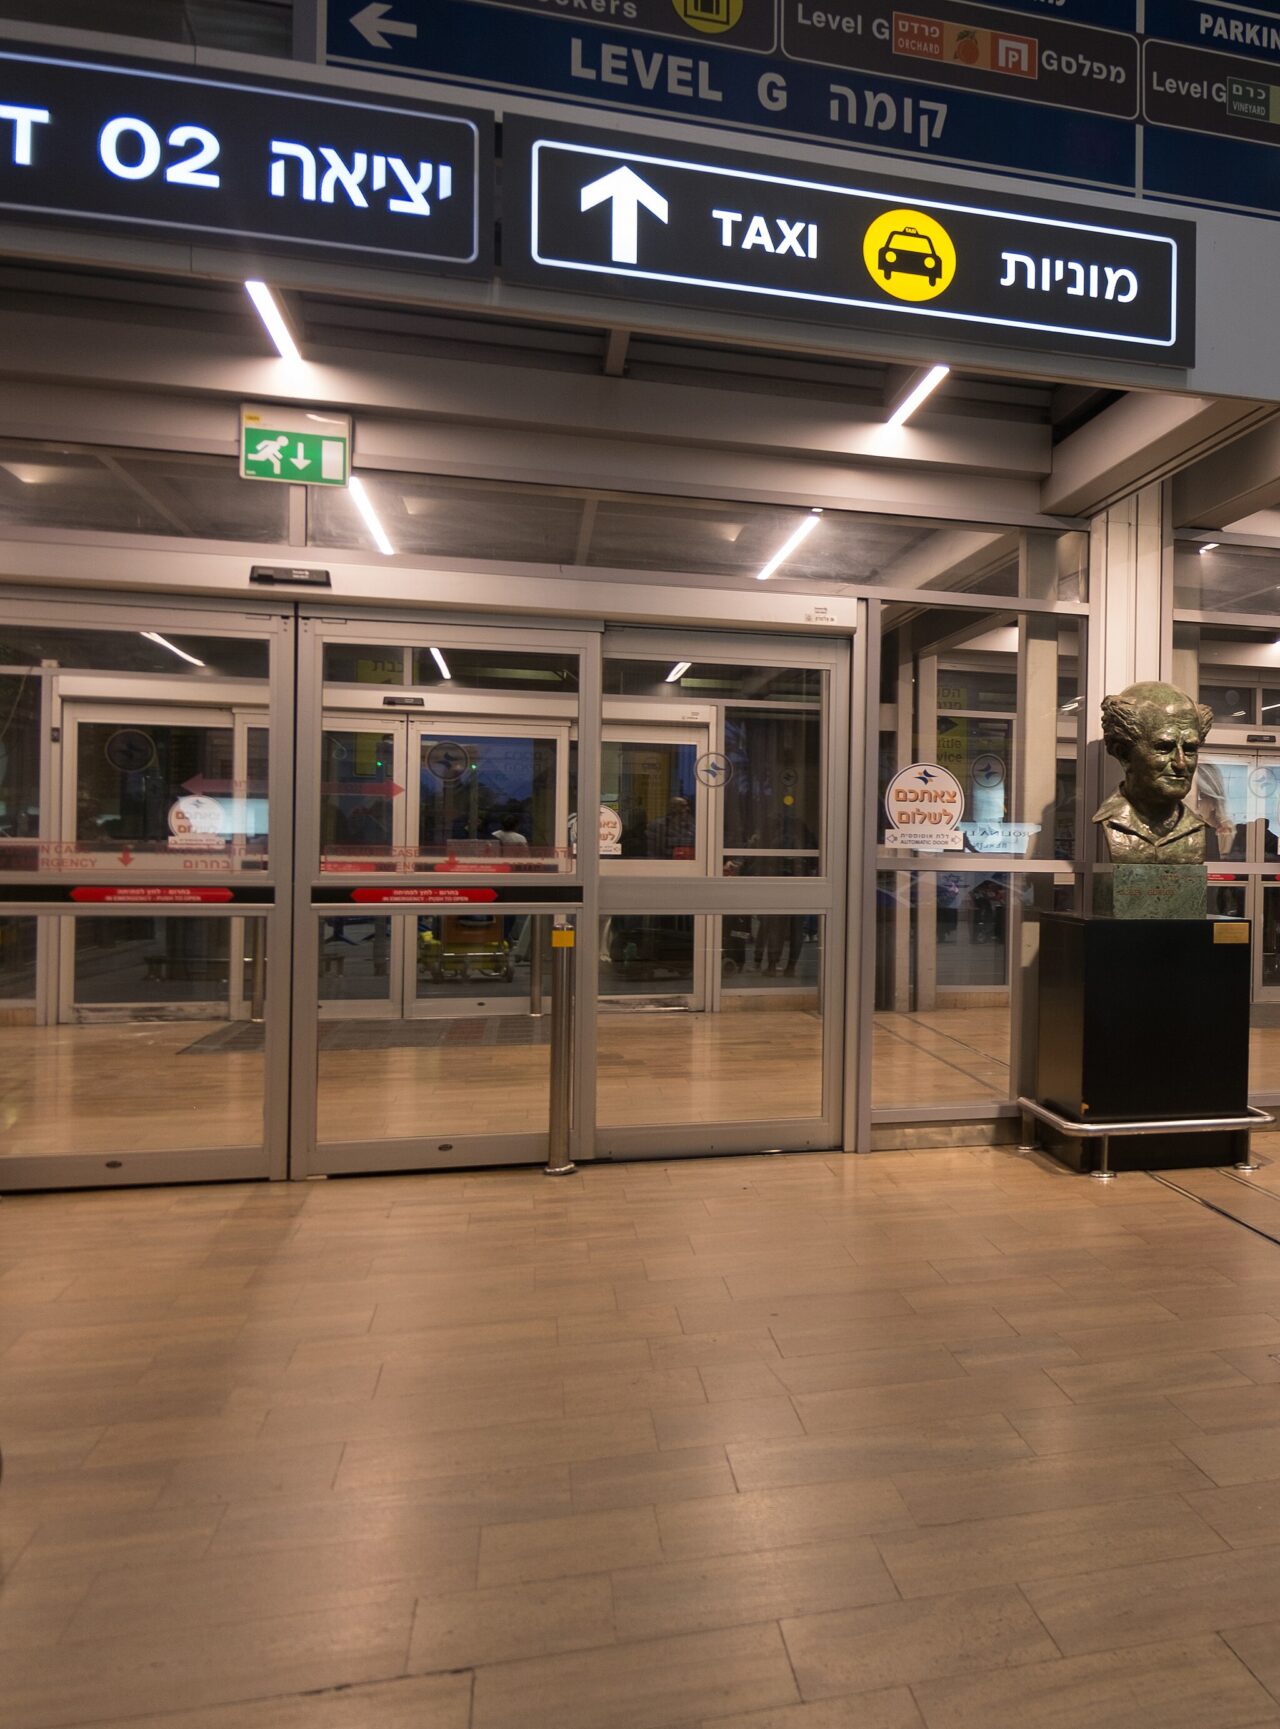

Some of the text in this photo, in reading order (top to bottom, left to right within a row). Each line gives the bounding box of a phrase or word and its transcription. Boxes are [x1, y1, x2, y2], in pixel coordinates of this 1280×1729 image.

[797, 3, 891, 40] Level G
[898, 19, 940, 38] פרדס
[898, 38, 941, 55] ORCHARD
[570, 37, 788, 112] LEVEL G
[1060, 53, 1127, 84] מפלס
[1152, 71, 1227, 103] Level G
[1232, 83, 1267, 100] כרם
[828, 83, 948, 148] קומה
[1232, 101, 1266, 117] VINEYARD
[270, 139, 452, 216] יציאה
[711, 208, 819, 260] TAXI
[1000, 250, 1138, 303] מוניות
[894, 788, 957, 804] צאתכם
[897, 808, 954, 826] לשלום
[183, 858, 232, 870] בחרום
